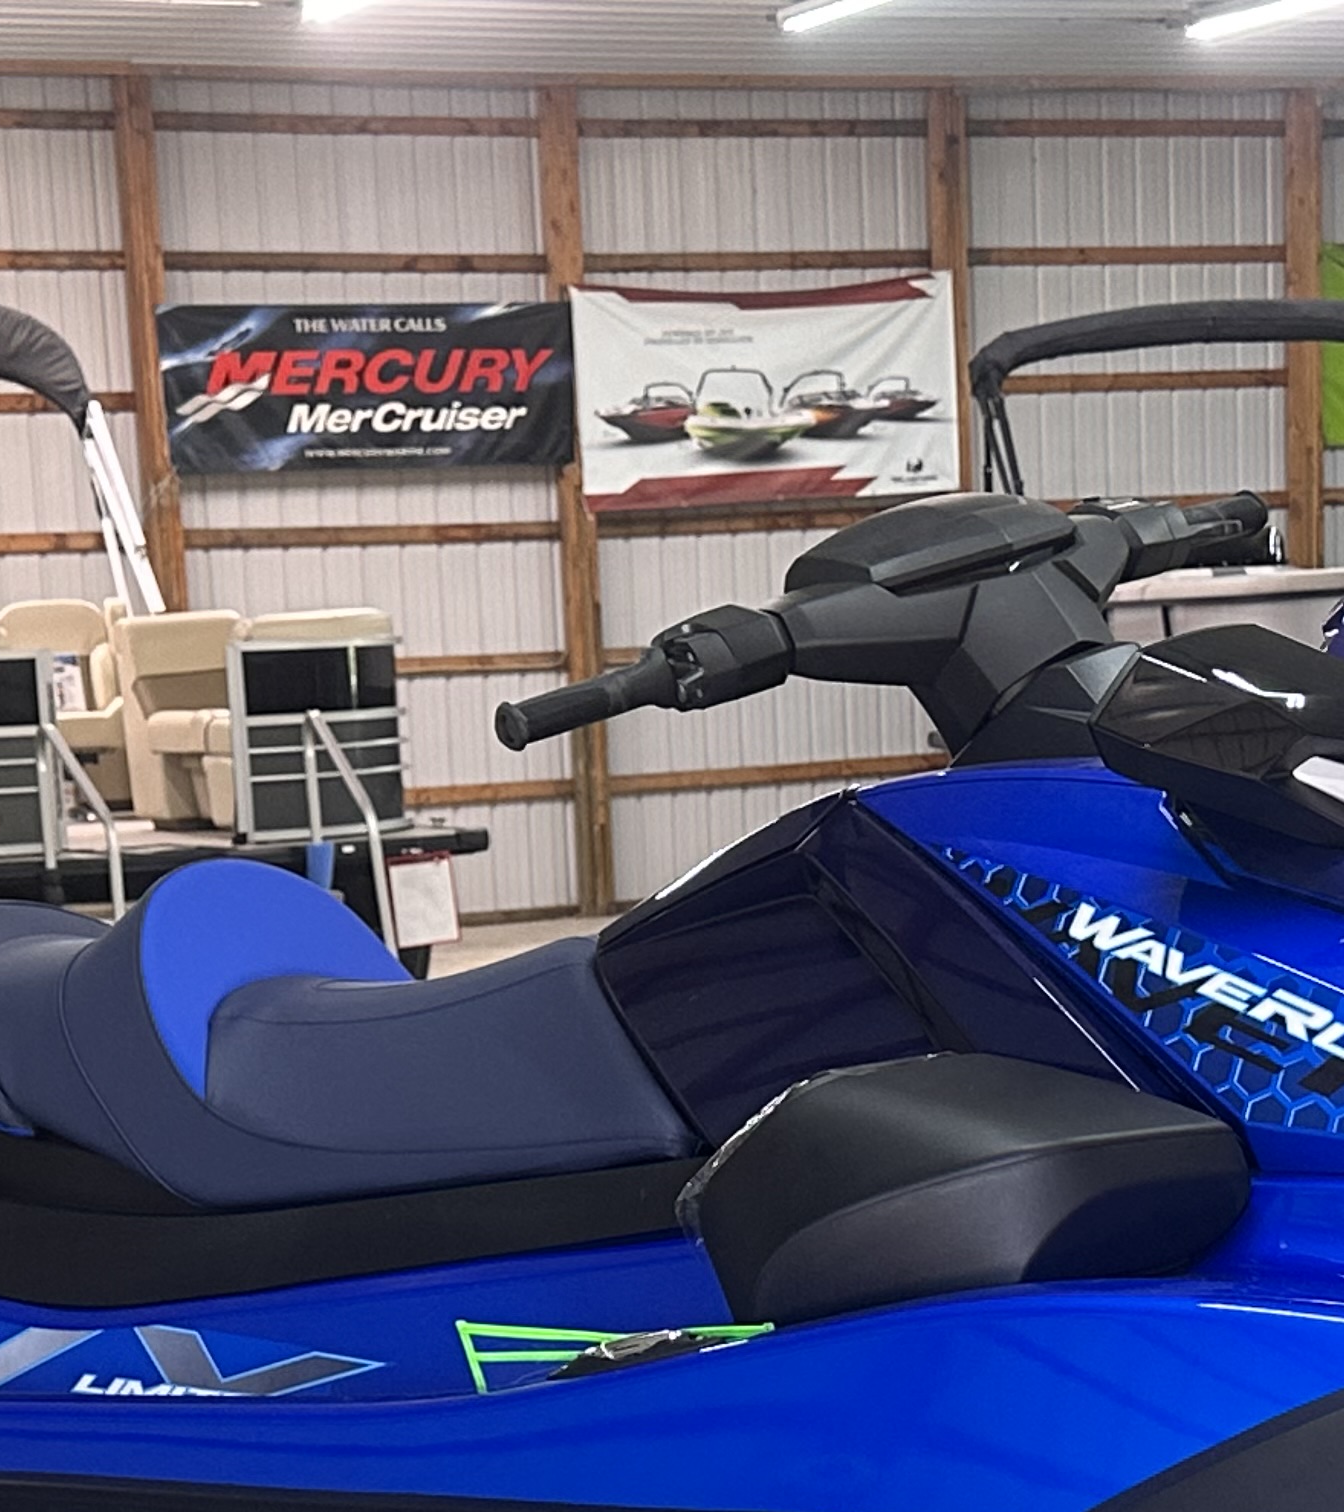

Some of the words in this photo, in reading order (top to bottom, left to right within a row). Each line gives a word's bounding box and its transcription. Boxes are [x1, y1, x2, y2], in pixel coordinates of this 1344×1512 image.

[293, 317, 327, 333] THE
[329, 317, 392, 332] WATER
[393, 316, 448, 332] CALLS
[205, 349, 554, 397] MERCURY
[286, 400, 528, 434] MerCruiser
